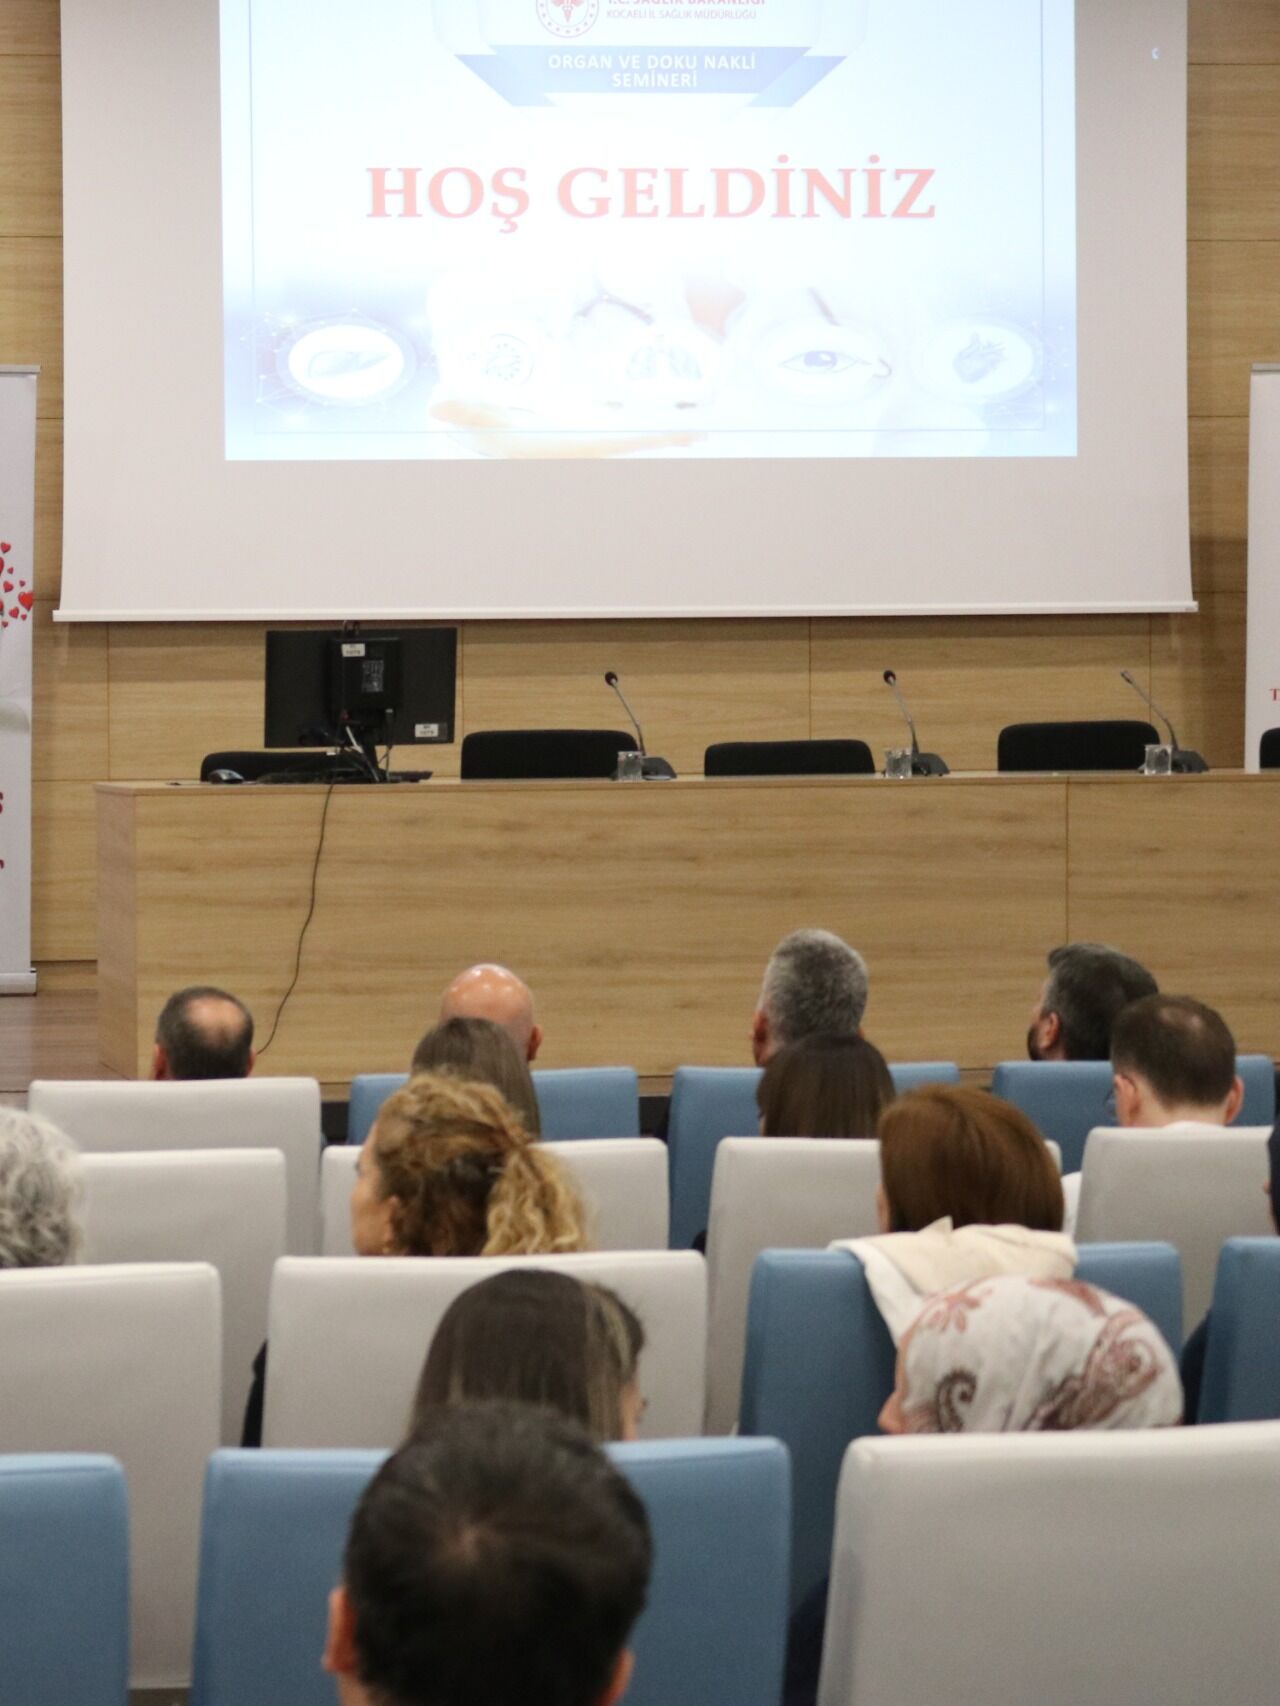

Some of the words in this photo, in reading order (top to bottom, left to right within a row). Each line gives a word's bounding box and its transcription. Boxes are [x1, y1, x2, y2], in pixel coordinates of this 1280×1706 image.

[547, 54, 613, 70] ORGAN
[618, 54, 641, 70] VE
[647, 54, 697, 70] DOKU
[704, 51, 757, 70] NAKLİ
[611, 70, 698, 88] SEMİNERİ
[366, 166, 531, 234] HOŞ
[557, 154, 937, 219] GELDİNİZ
